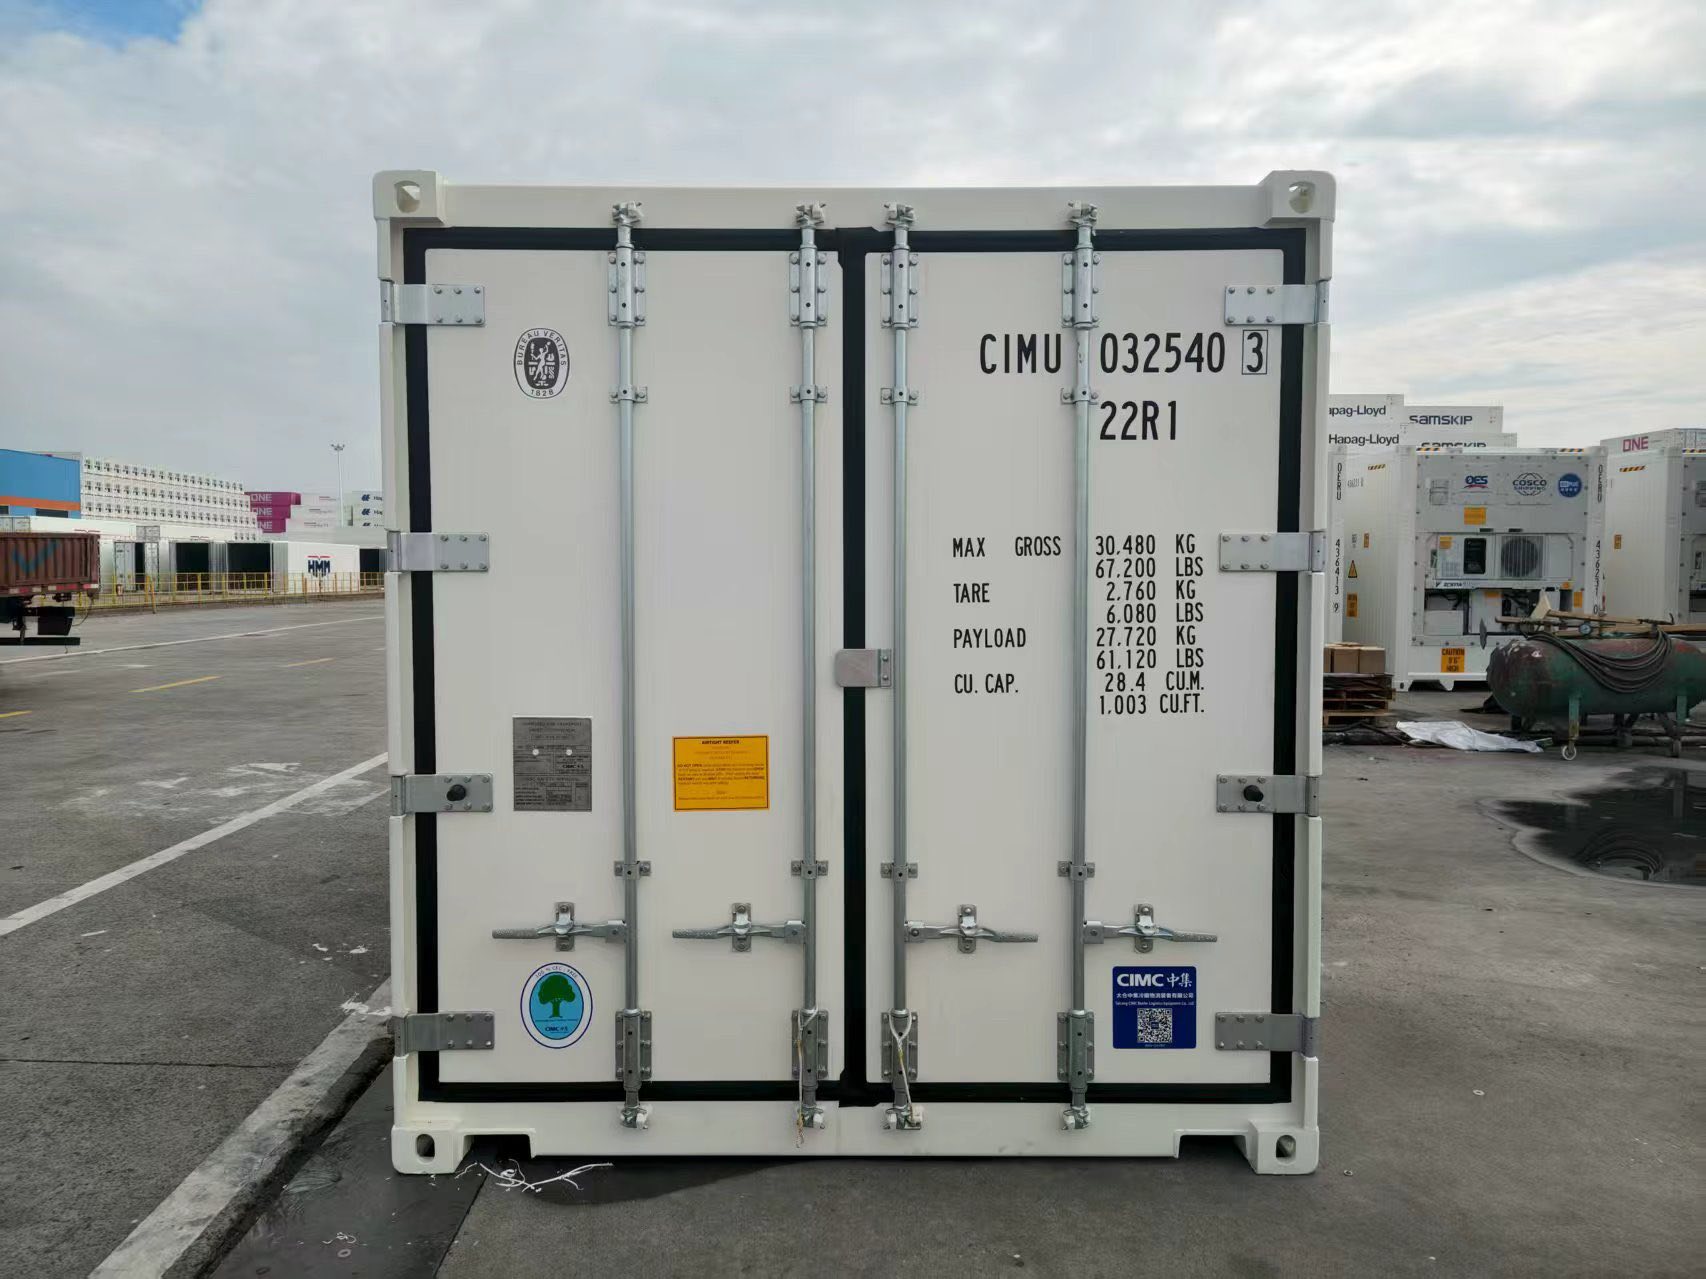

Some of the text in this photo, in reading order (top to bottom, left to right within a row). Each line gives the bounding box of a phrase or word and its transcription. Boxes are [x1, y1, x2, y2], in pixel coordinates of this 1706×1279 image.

[517, 330, 567, 366] BUREAU VERITAS
[980, 332, 1263, 374] CIMU 032540 3
[531, 389, 554, 397] 1828
[1100, 401, 1176, 440] 22R1
[1329, 405, 1386, 417] pag-Lloyd
[1623, 436, 1649, 452] ONE
[953, 534, 1195, 557] MAX GROSS 30,480 KG
[307, 560, 331, 578] HMM
[1096, 557, 1203, 578] 67,200 LBS
[954, 580, 1195, 603] TARE 2,760 KG
[1107, 602, 1203, 624] 6,080 LBS
[954, 625, 1195, 648] PAYLOAD 27,720 KG
[1097, 648, 1203, 669] 61,120 LBS
[955, 671, 1204, 693] CU. CAP. 28.4 CU.M.
[1100, 693, 1204, 714] 1,003 CU.FT.
[1117, 972, 1192, 988] CIMC 中集
